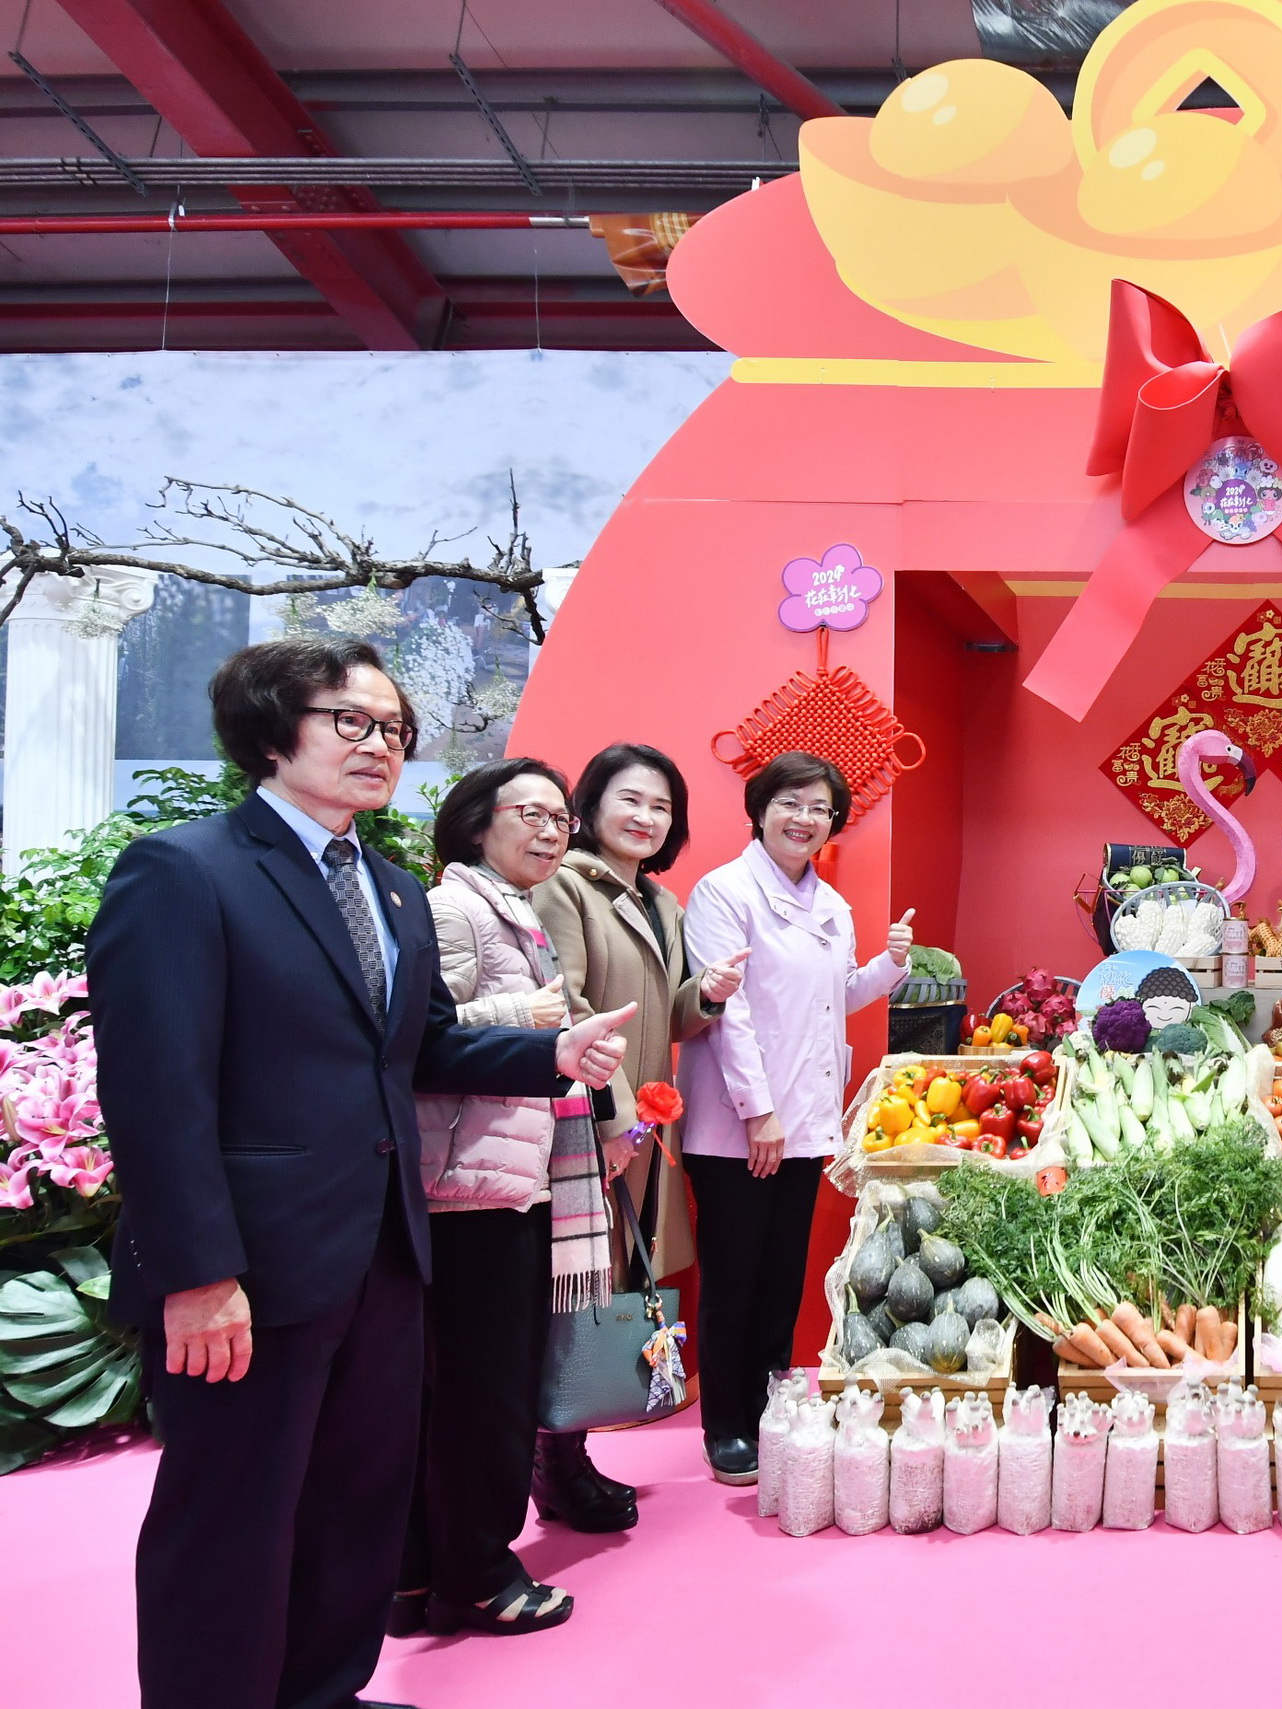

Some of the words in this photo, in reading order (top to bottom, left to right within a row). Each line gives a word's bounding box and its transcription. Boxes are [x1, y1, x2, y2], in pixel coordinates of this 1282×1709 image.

[812, 565, 844, 586] 2024
[805, 584, 861, 608] 花在彰化
